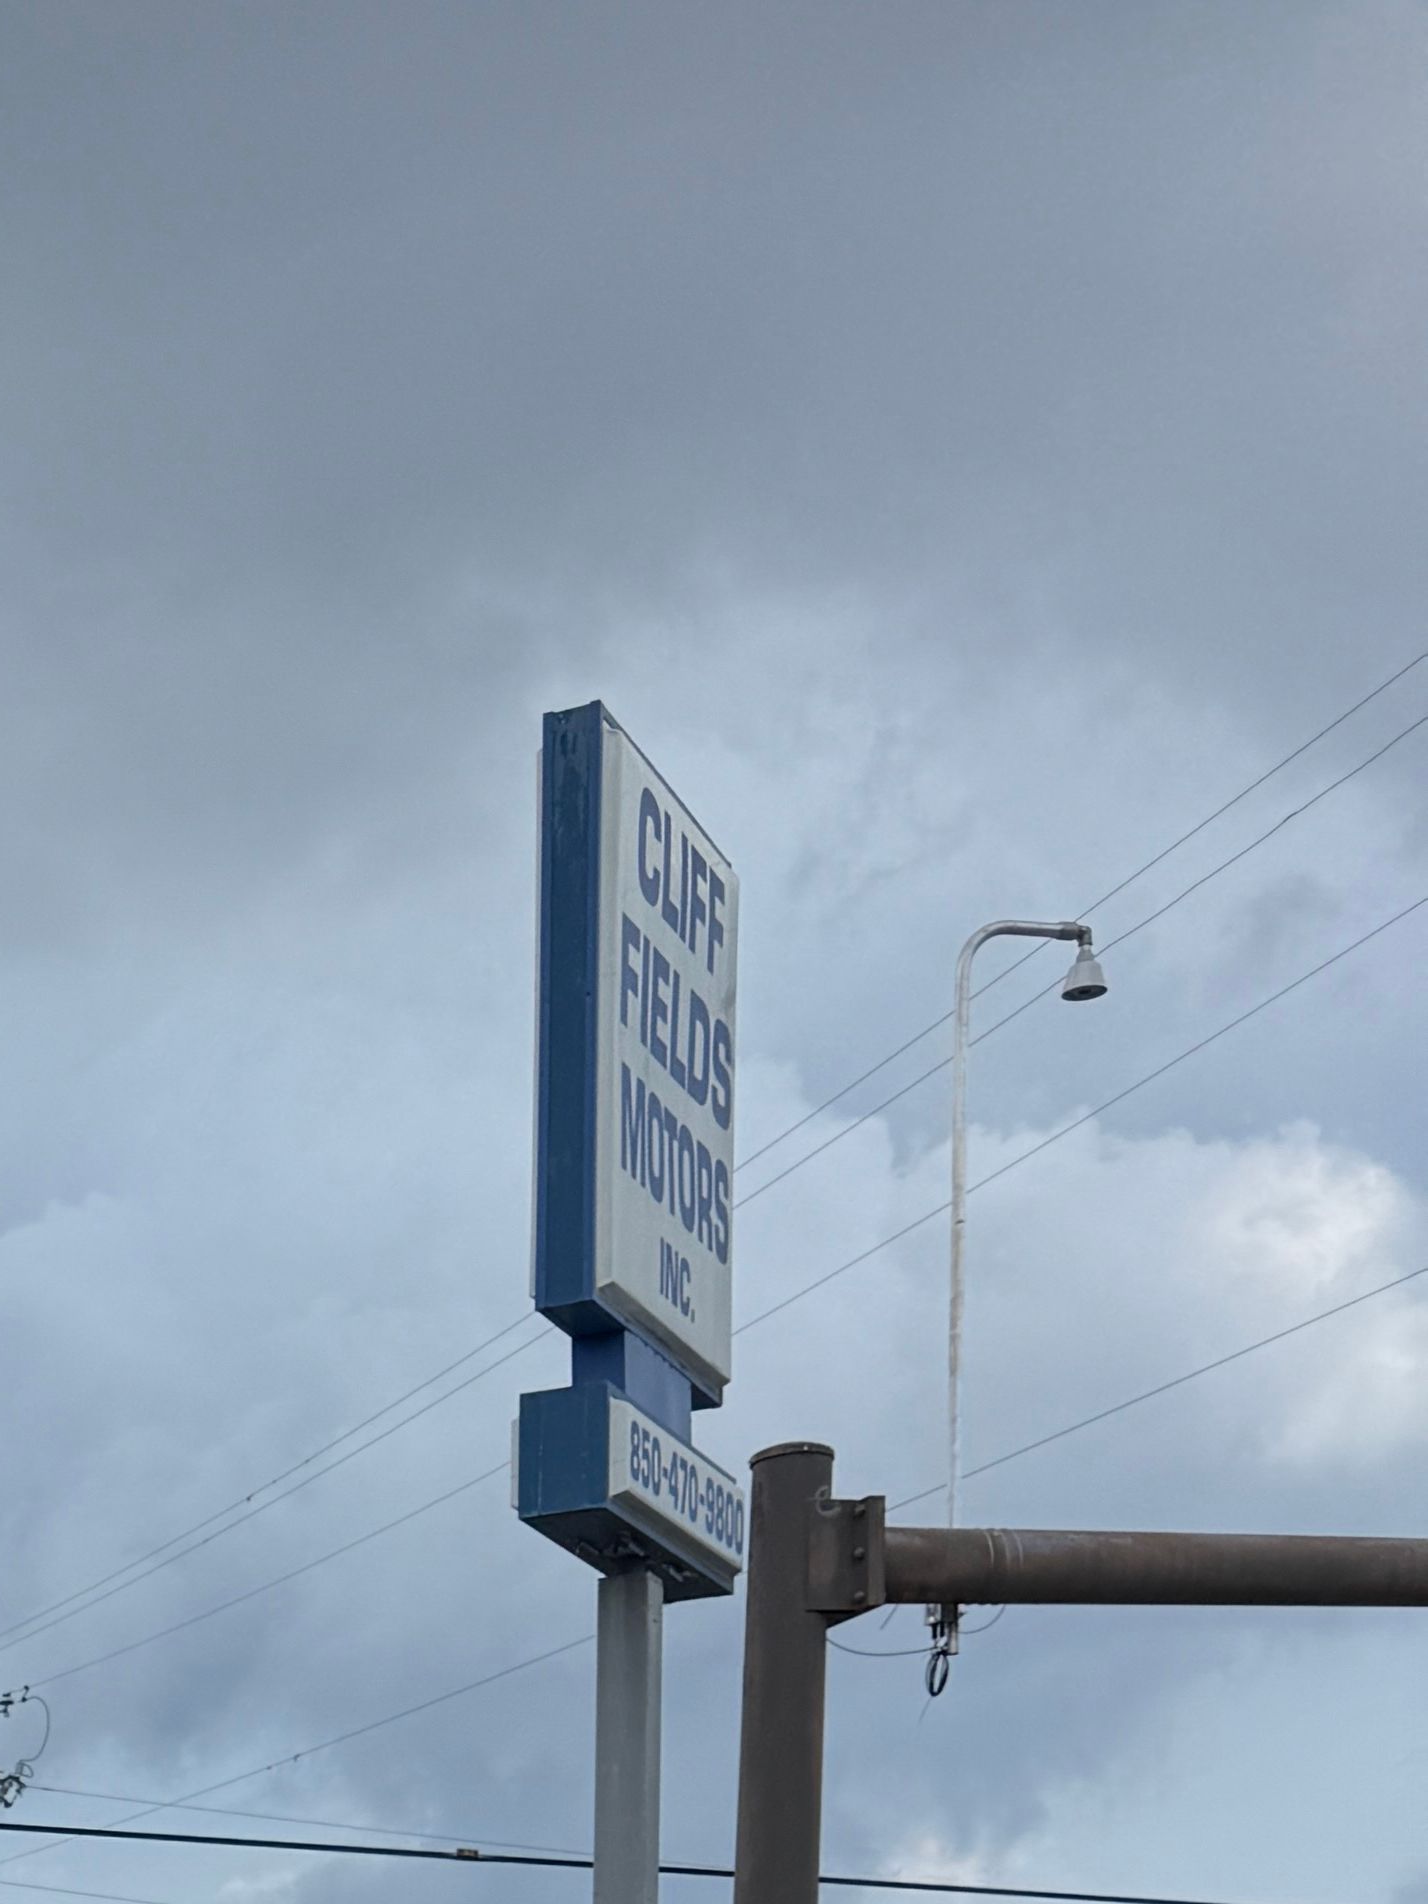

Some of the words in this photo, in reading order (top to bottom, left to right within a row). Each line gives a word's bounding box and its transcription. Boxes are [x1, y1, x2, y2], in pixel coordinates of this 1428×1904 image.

[638, 786, 726, 976] CLIFF
[620, 911, 732, 1131] FIELDS
[621, 1061, 729, 1266] MOTORS
[660, 1236, 695, 1324] INC.
[630, 1420, 744, 1555] 850-470-9800
